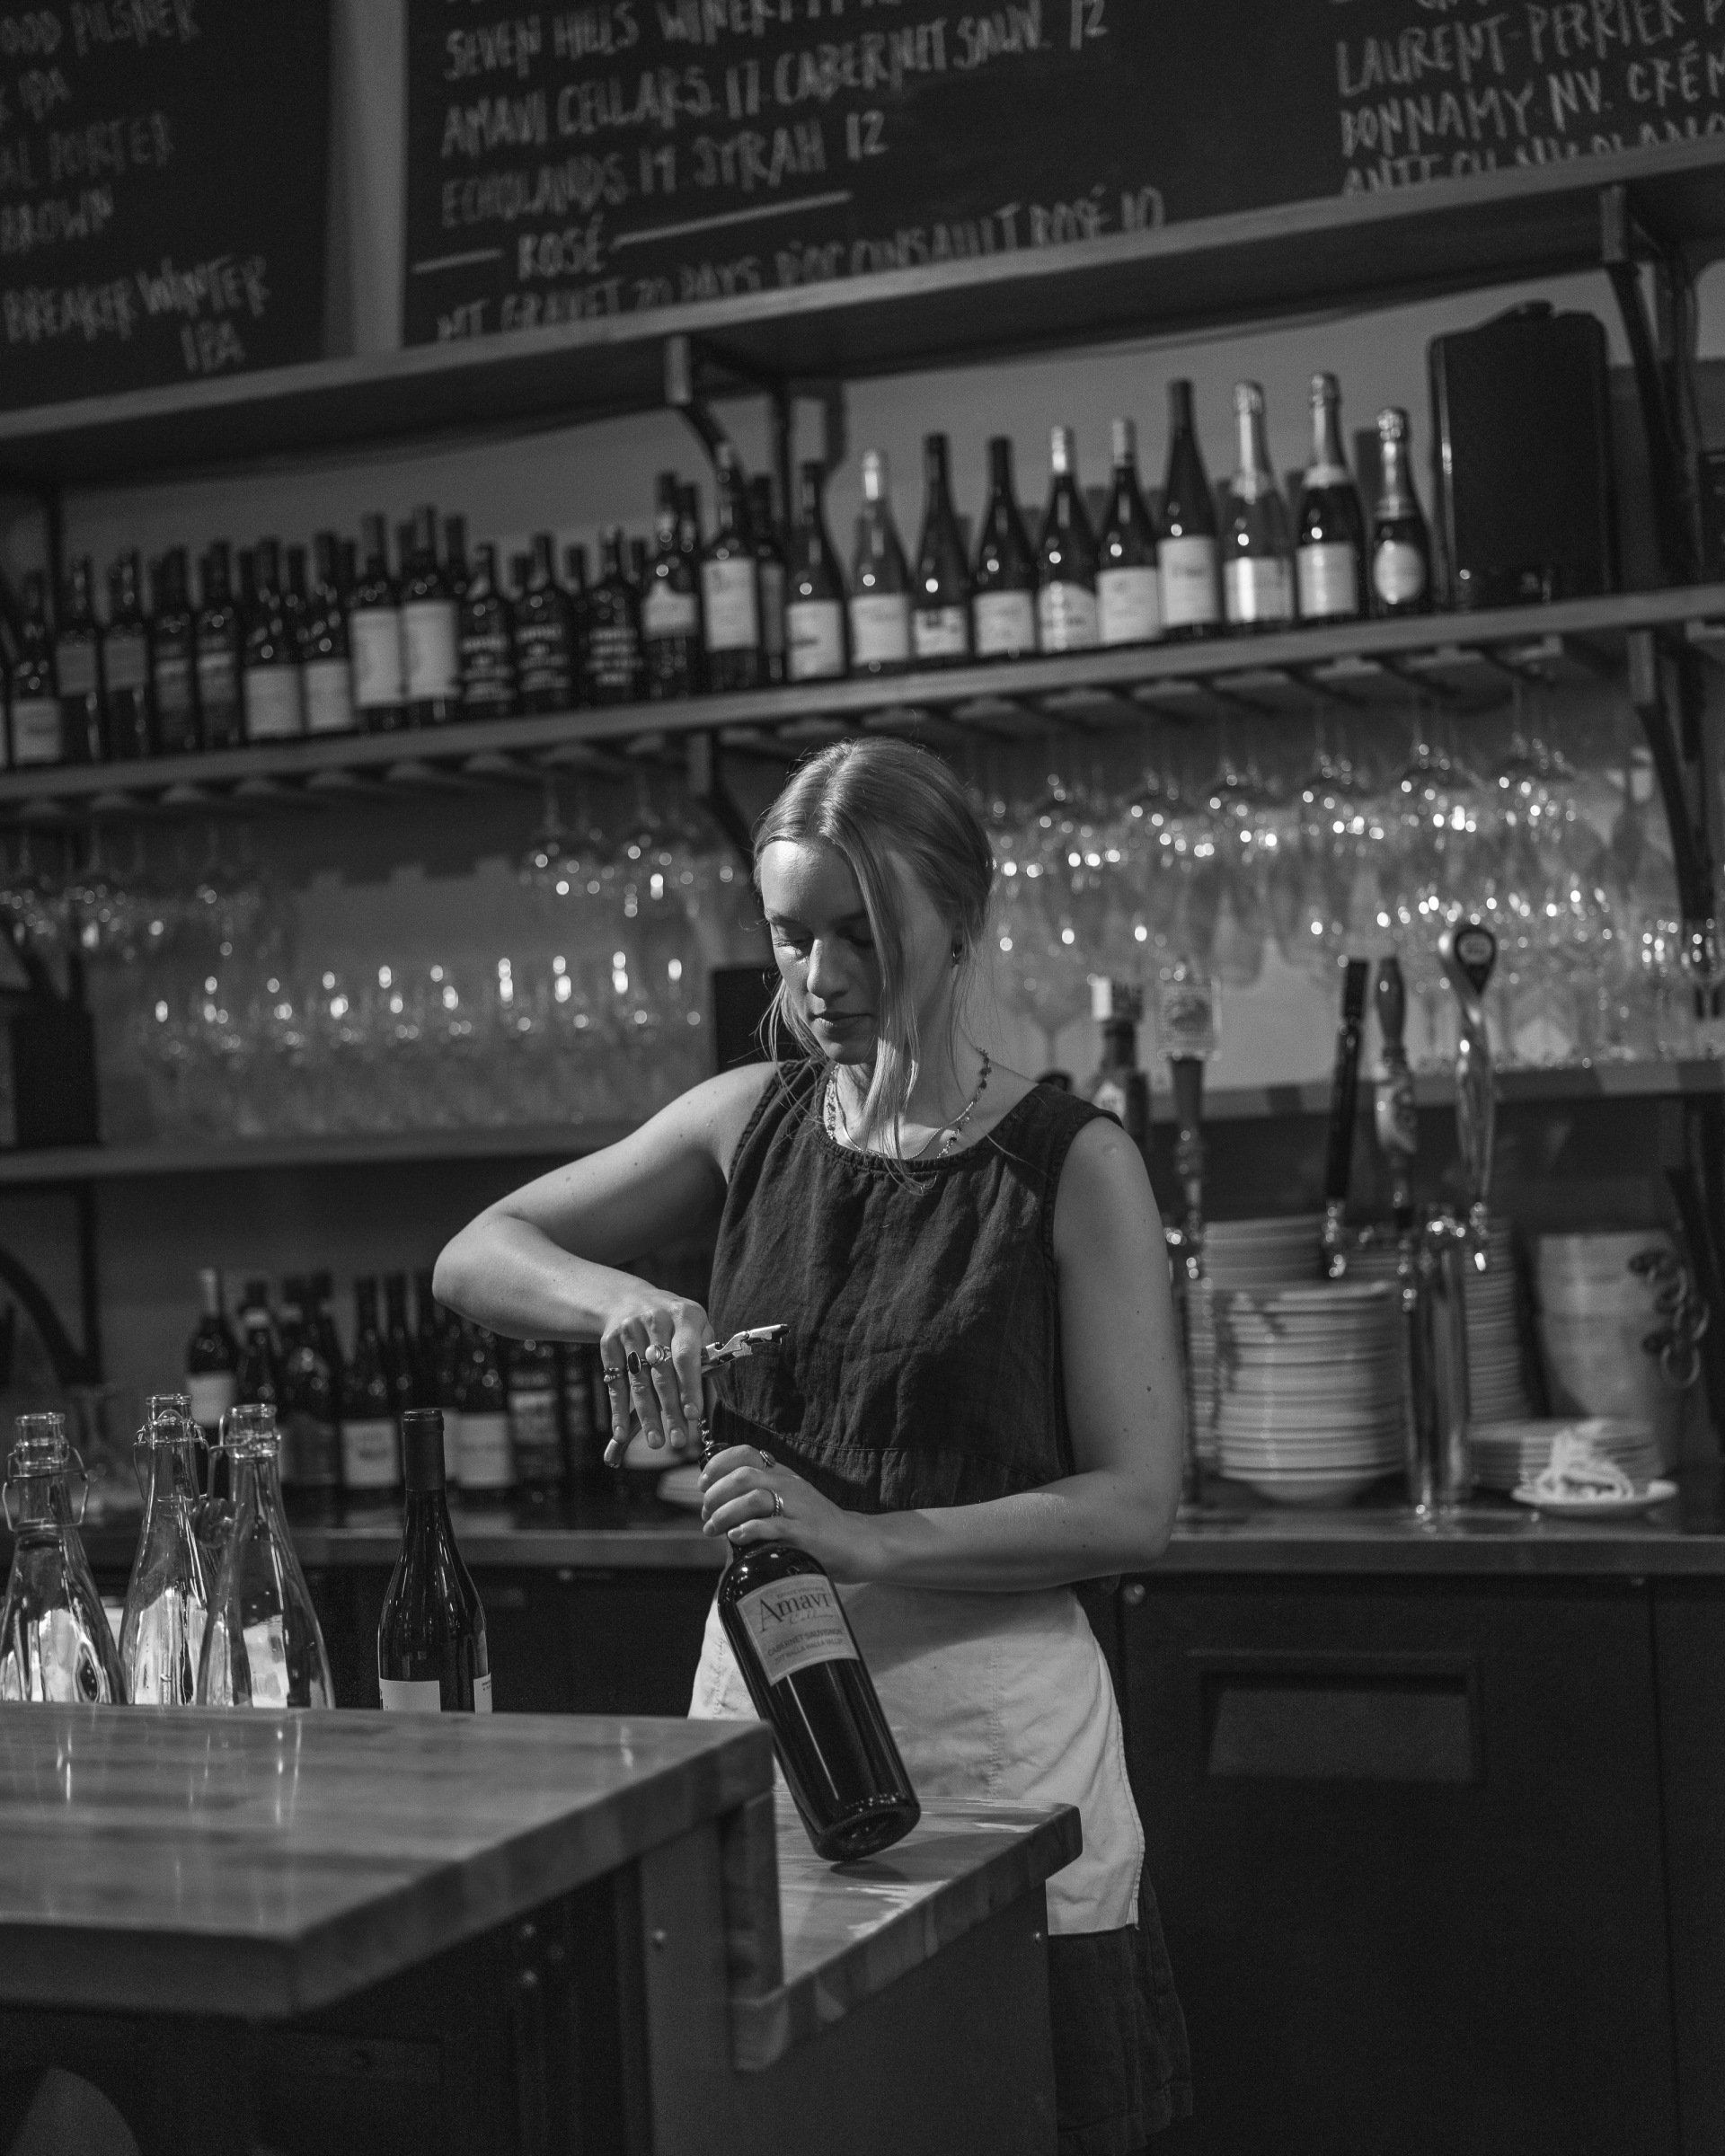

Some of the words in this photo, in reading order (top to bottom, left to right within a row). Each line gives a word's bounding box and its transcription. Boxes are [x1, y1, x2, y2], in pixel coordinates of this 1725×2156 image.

[445, 15, 541, 81] SEVEN
[553, 2, 641, 60] HILLS
[773, 27, 949, 105] CABERNET
[1069, 0, 1109, 51] 12
[693, 119, 827, 191] SYRAH
[845, 110, 889, 162] 12
[517, 211, 606, 281] ROSÉ
[135, 254, 270, 319] WINTER
[180, 318, 246, 373] IPA
[756, 1592, 830, 1633] Amavi
